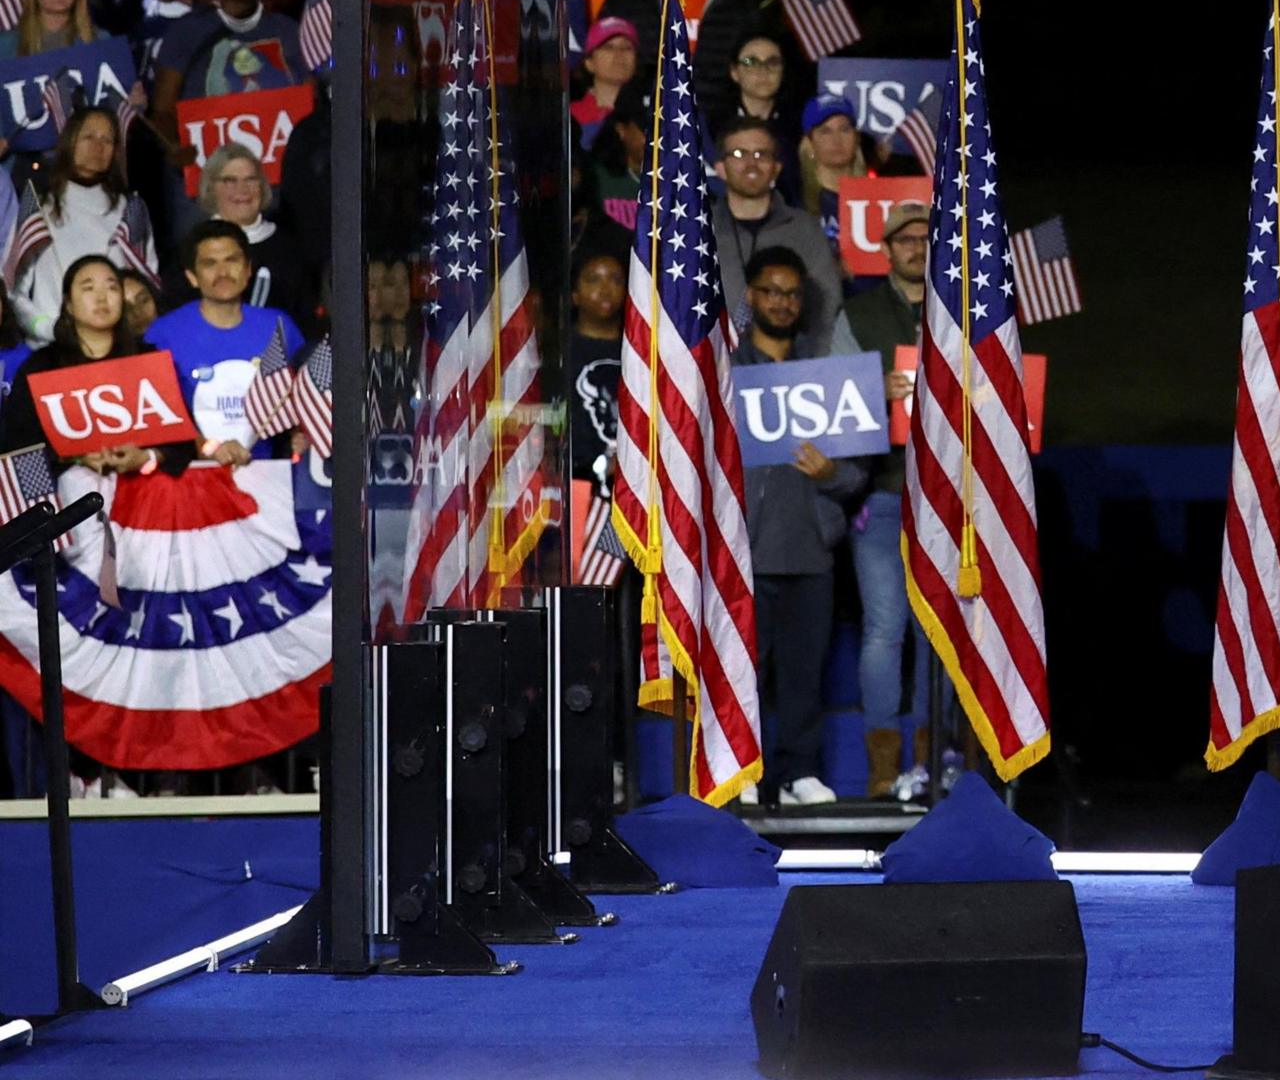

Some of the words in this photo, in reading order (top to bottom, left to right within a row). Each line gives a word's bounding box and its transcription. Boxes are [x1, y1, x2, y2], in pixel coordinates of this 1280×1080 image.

[4, 62, 129, 130] UA
[41, 378, 184, 440] USA
[740, 378, 881, 442] USA
